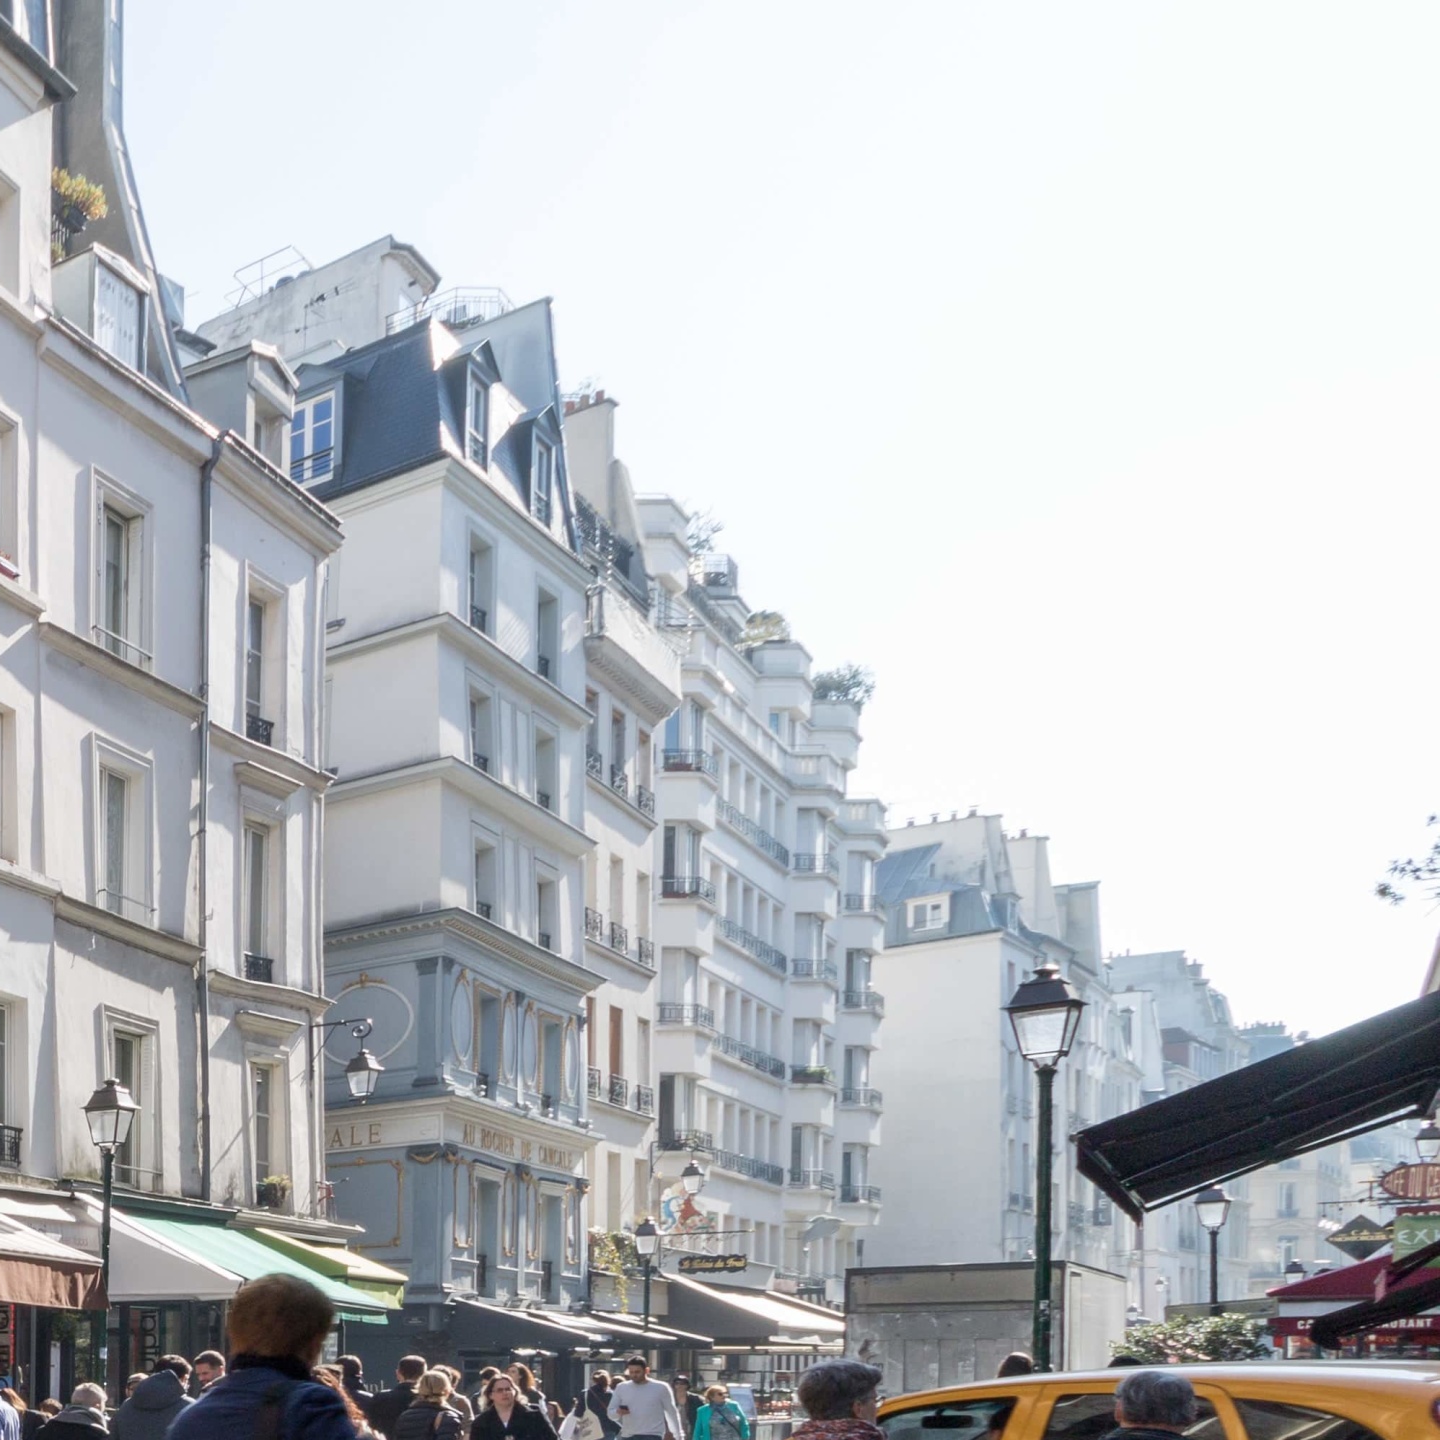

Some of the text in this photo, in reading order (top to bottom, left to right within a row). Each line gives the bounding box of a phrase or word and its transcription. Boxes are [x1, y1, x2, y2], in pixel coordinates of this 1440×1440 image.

[326, 1122, 383, 1148] ALE
[462, 1122, 574, 1171] AU ROCHER DE CANCALE
